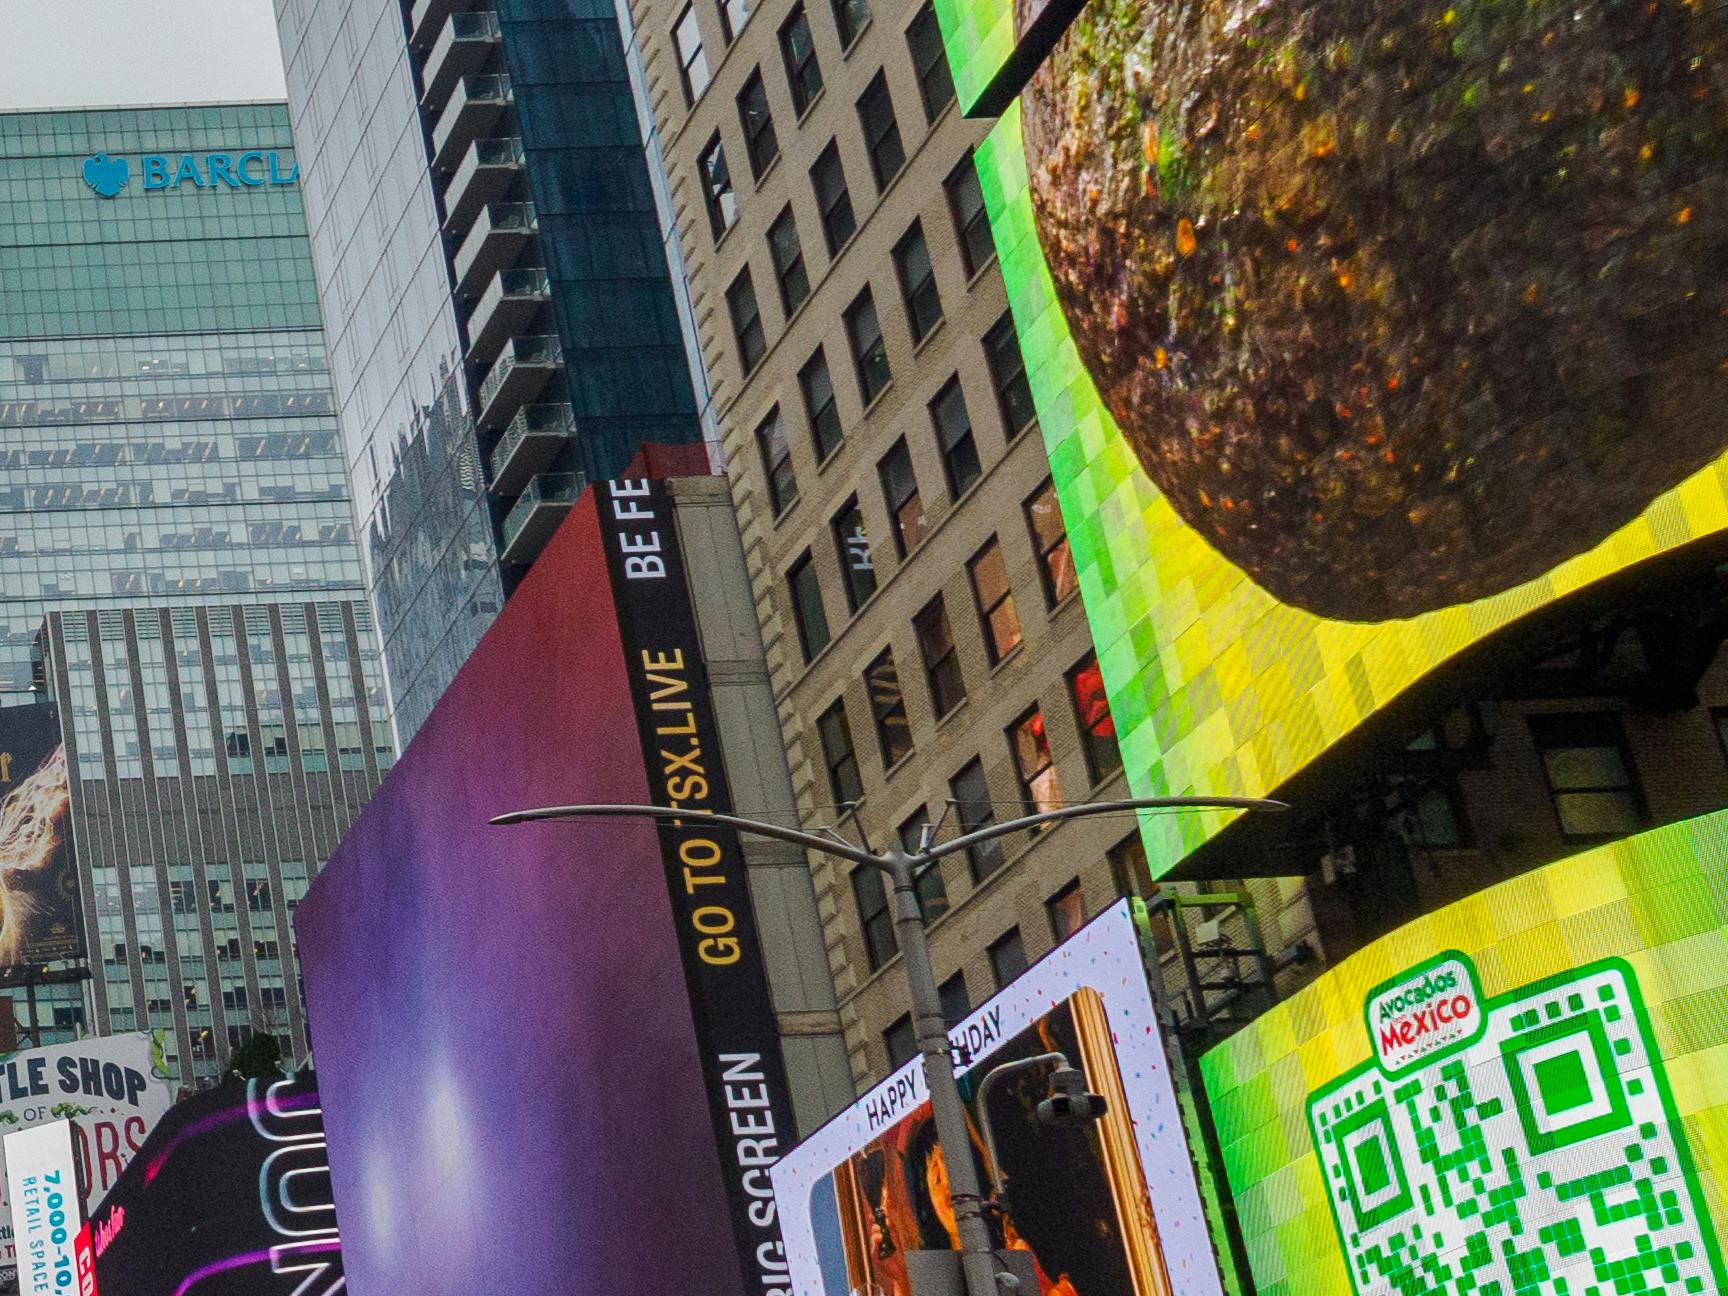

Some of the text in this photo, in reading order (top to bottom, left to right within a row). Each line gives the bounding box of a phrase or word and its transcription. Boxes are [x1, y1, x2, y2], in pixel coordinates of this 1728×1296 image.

[623, 515, 668, 582] BE
[640, 647, 742, 966] GO TO TSX.LIVE
[1379, 994, 1472, 1066] Mexico
[56, 1055, 147, 1106] SHOP
[864, 1068, 918, 1132] HAPPY
[23, 1106, 47, 1122] OF
[737, 1052, 782, 1228] SCREEN
[22, 1176, 41, 1236] RETAIL
[29, 1239, 48, 1292] SPACE
